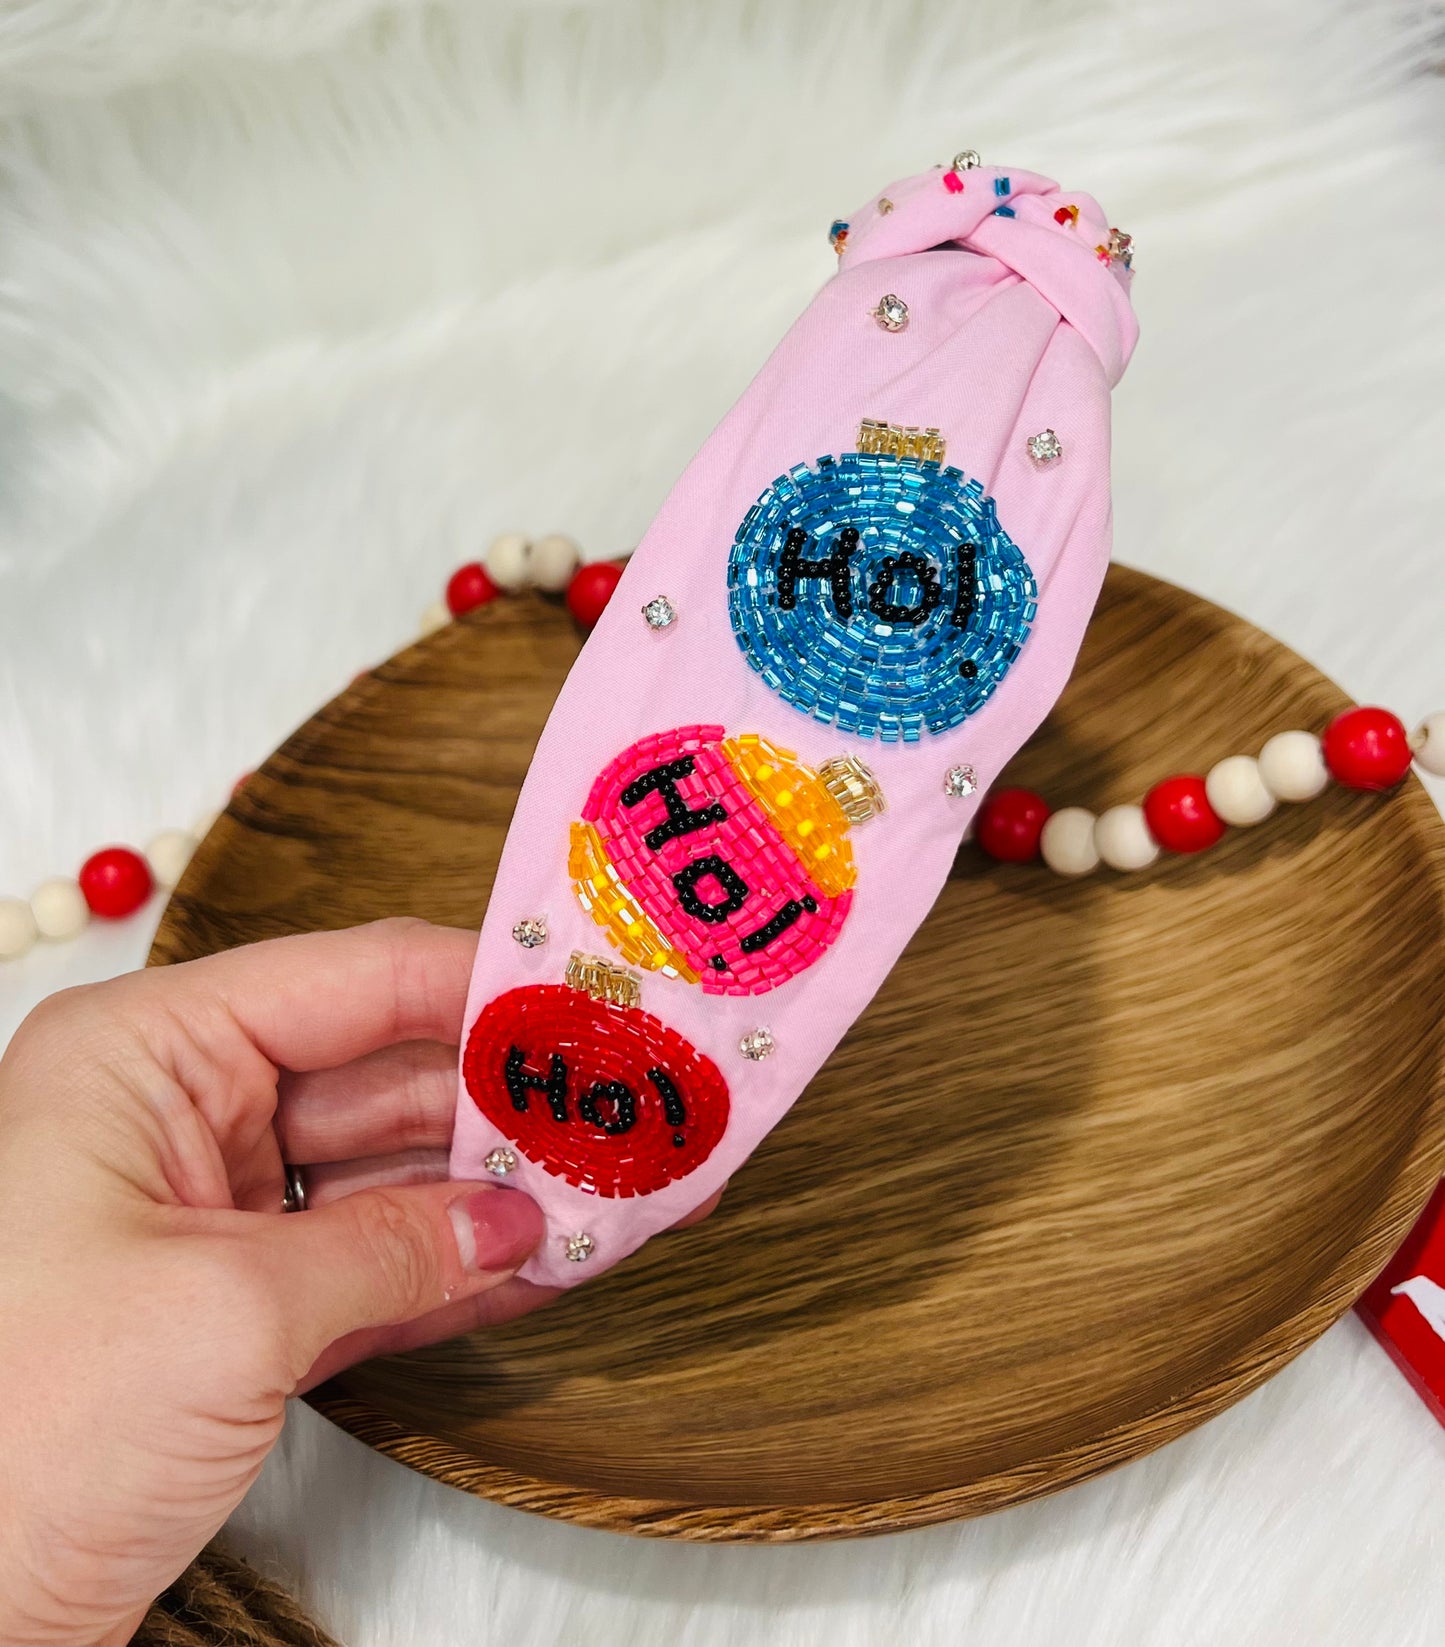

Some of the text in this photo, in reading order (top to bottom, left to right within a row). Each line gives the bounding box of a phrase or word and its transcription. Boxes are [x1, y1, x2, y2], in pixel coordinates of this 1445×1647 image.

[778, 527, 977, 678] Ho!
[621, 755, 817, 970] Ho!
[505, 1045, 685, 1147] Ho!
